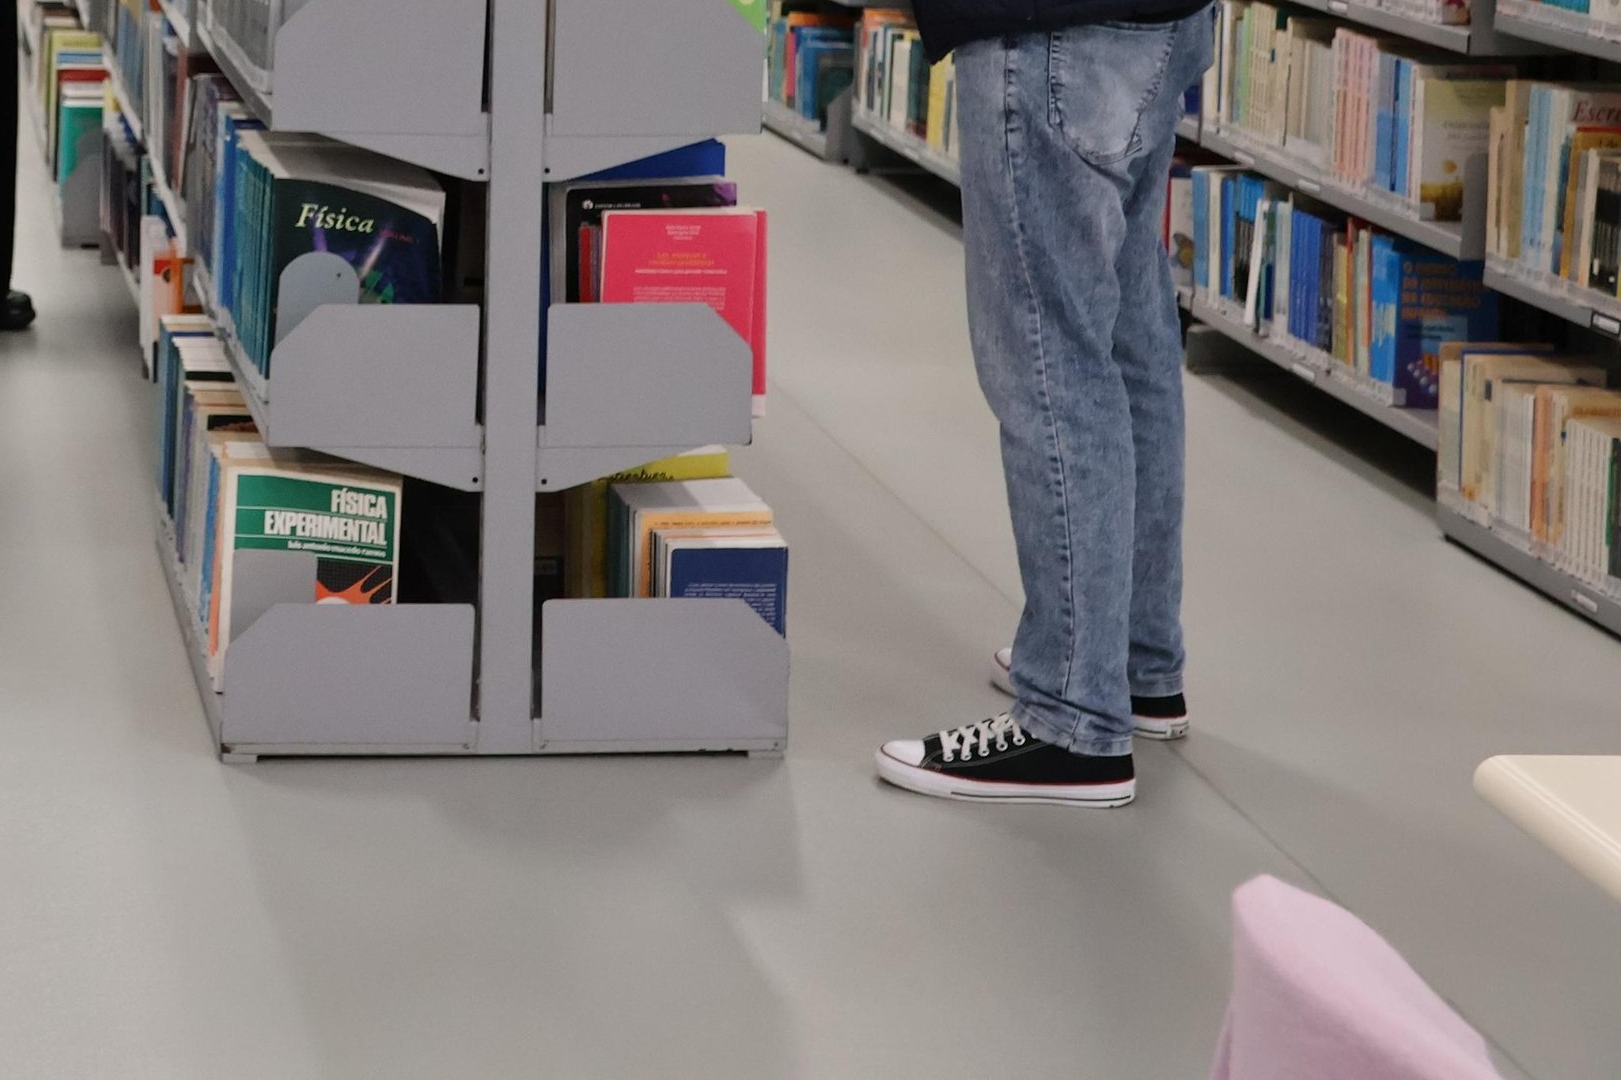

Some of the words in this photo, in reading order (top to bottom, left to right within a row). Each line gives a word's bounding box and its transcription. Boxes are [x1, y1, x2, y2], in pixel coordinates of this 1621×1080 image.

[295, 203, 375, 233] Física
[331, 488, 388, 519] FÍSICA
[264, 510, 388, 545] EXPERIMENTAL
